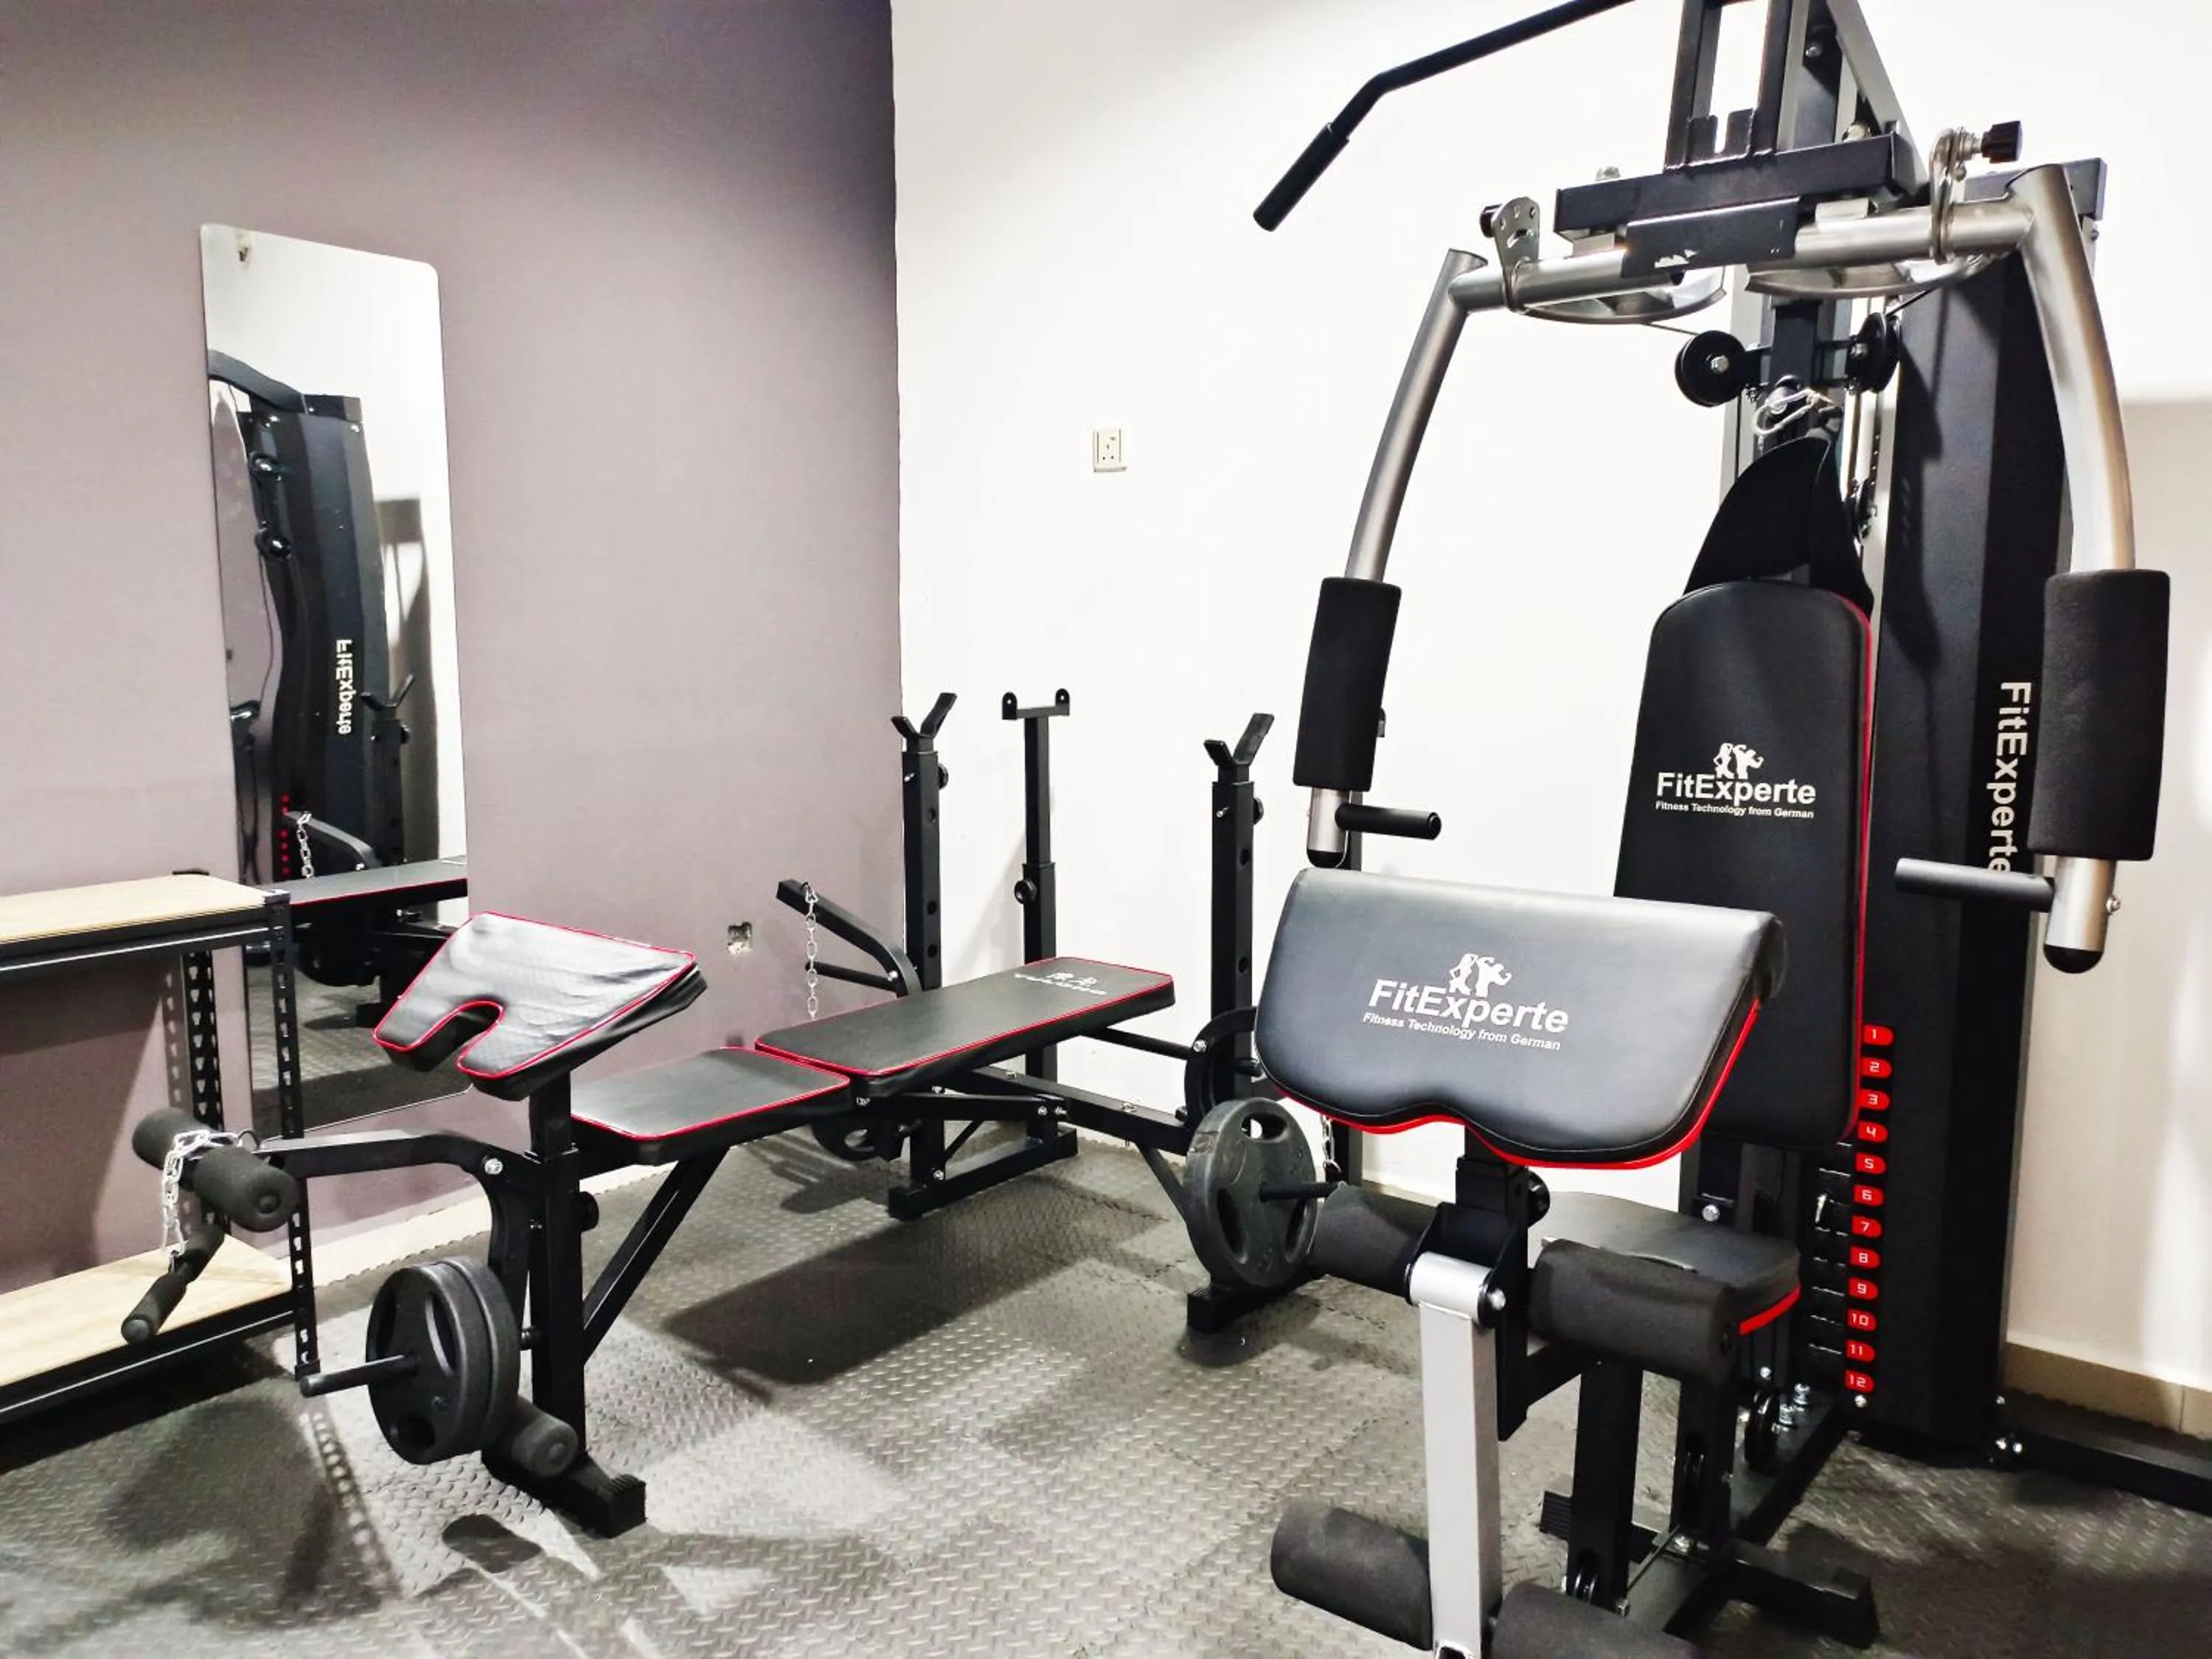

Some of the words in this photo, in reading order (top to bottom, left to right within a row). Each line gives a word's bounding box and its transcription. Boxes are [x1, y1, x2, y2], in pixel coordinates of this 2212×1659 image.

[1656, 772, 1817, 807] FitExperte
[1655, 801, 1689, 813] Fitness
[1691, 802, 1747, 817] Technology
[1748, 806, 1772, 816] from
[1773, 807, 1815, 819] German
[1368, 979, 1569, 1033] FitExperte
[1363, 1012, 1405, 1029] Fitness
[1408, 1018, 1476, 1040] Technology
[1478, 1029, 1508, 1043] from
[1510, 1033, 1561, 1051] German
[1871, 1029, 1877, 1040] 1
[1869, 1061, 1880, 1073] 2
[1868, 1093, 1879, 1105] 3
[1866, 1126, 1877, 1138] 4
[1864, 1158, 1874, 1169] 5
[1862, 1189, 1872, 1201] 6
[1860, 1221, 1870, 1232] 7
[1858, 1252, 1868, 1264] 8
[1857, 1283, 1867, 1295] 9
[1851, 1313, 1869, 1326] 10
[1849, 1344, 1864, 1357] 11
[1848, 1374, 1866, 1388] 12
